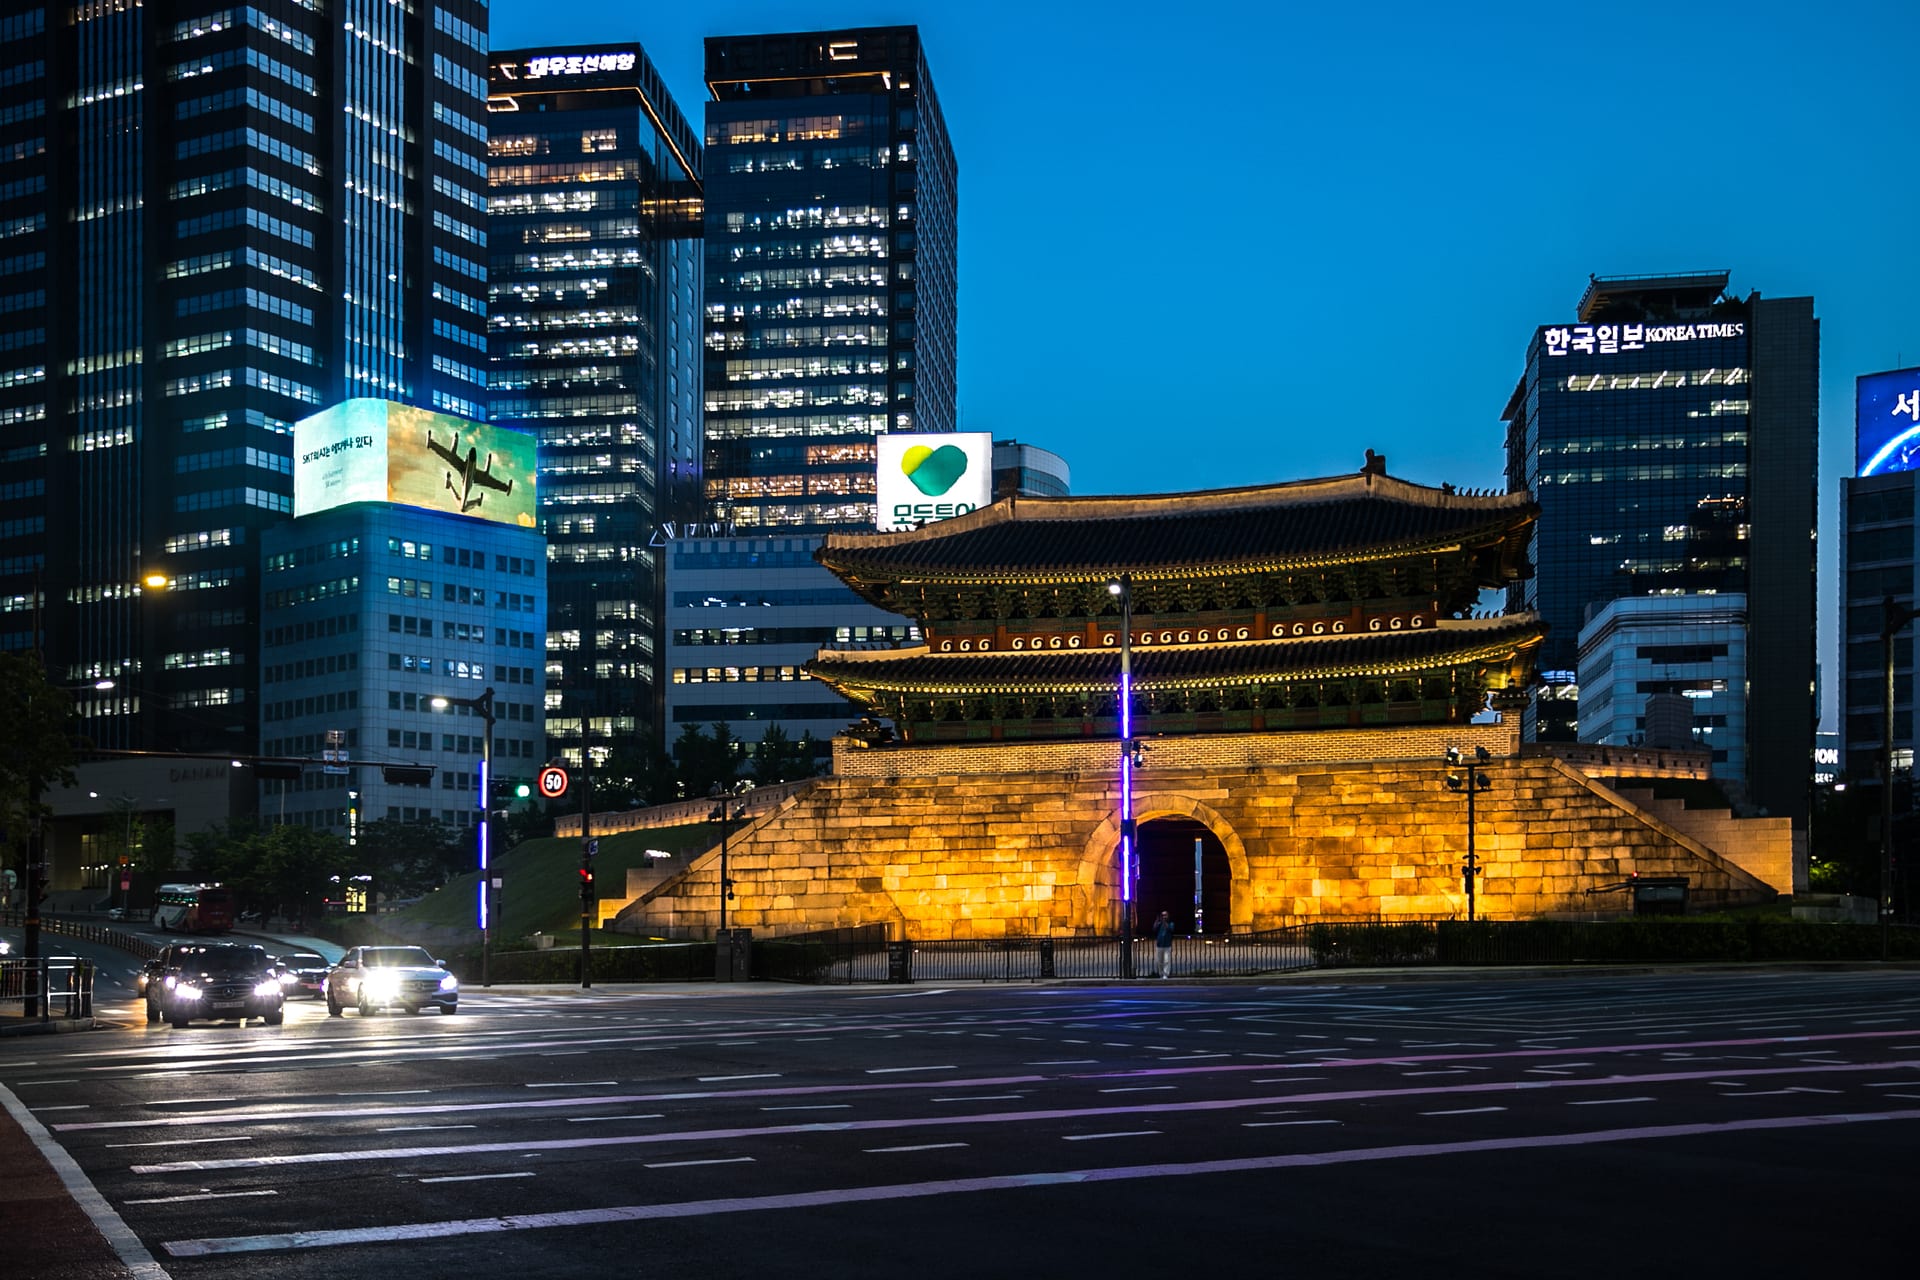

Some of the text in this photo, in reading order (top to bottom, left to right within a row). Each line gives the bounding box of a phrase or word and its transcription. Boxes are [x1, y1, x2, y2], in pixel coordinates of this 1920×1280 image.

[530, 54, 635, 76] 대우조선해양
[1545, 325, 1645, 356] 한국일보
[1645, 323, 1744, 343] KOREA TIMES
[355, 435, 373, 448] 있다
[545, 774, 562, 790] 50
